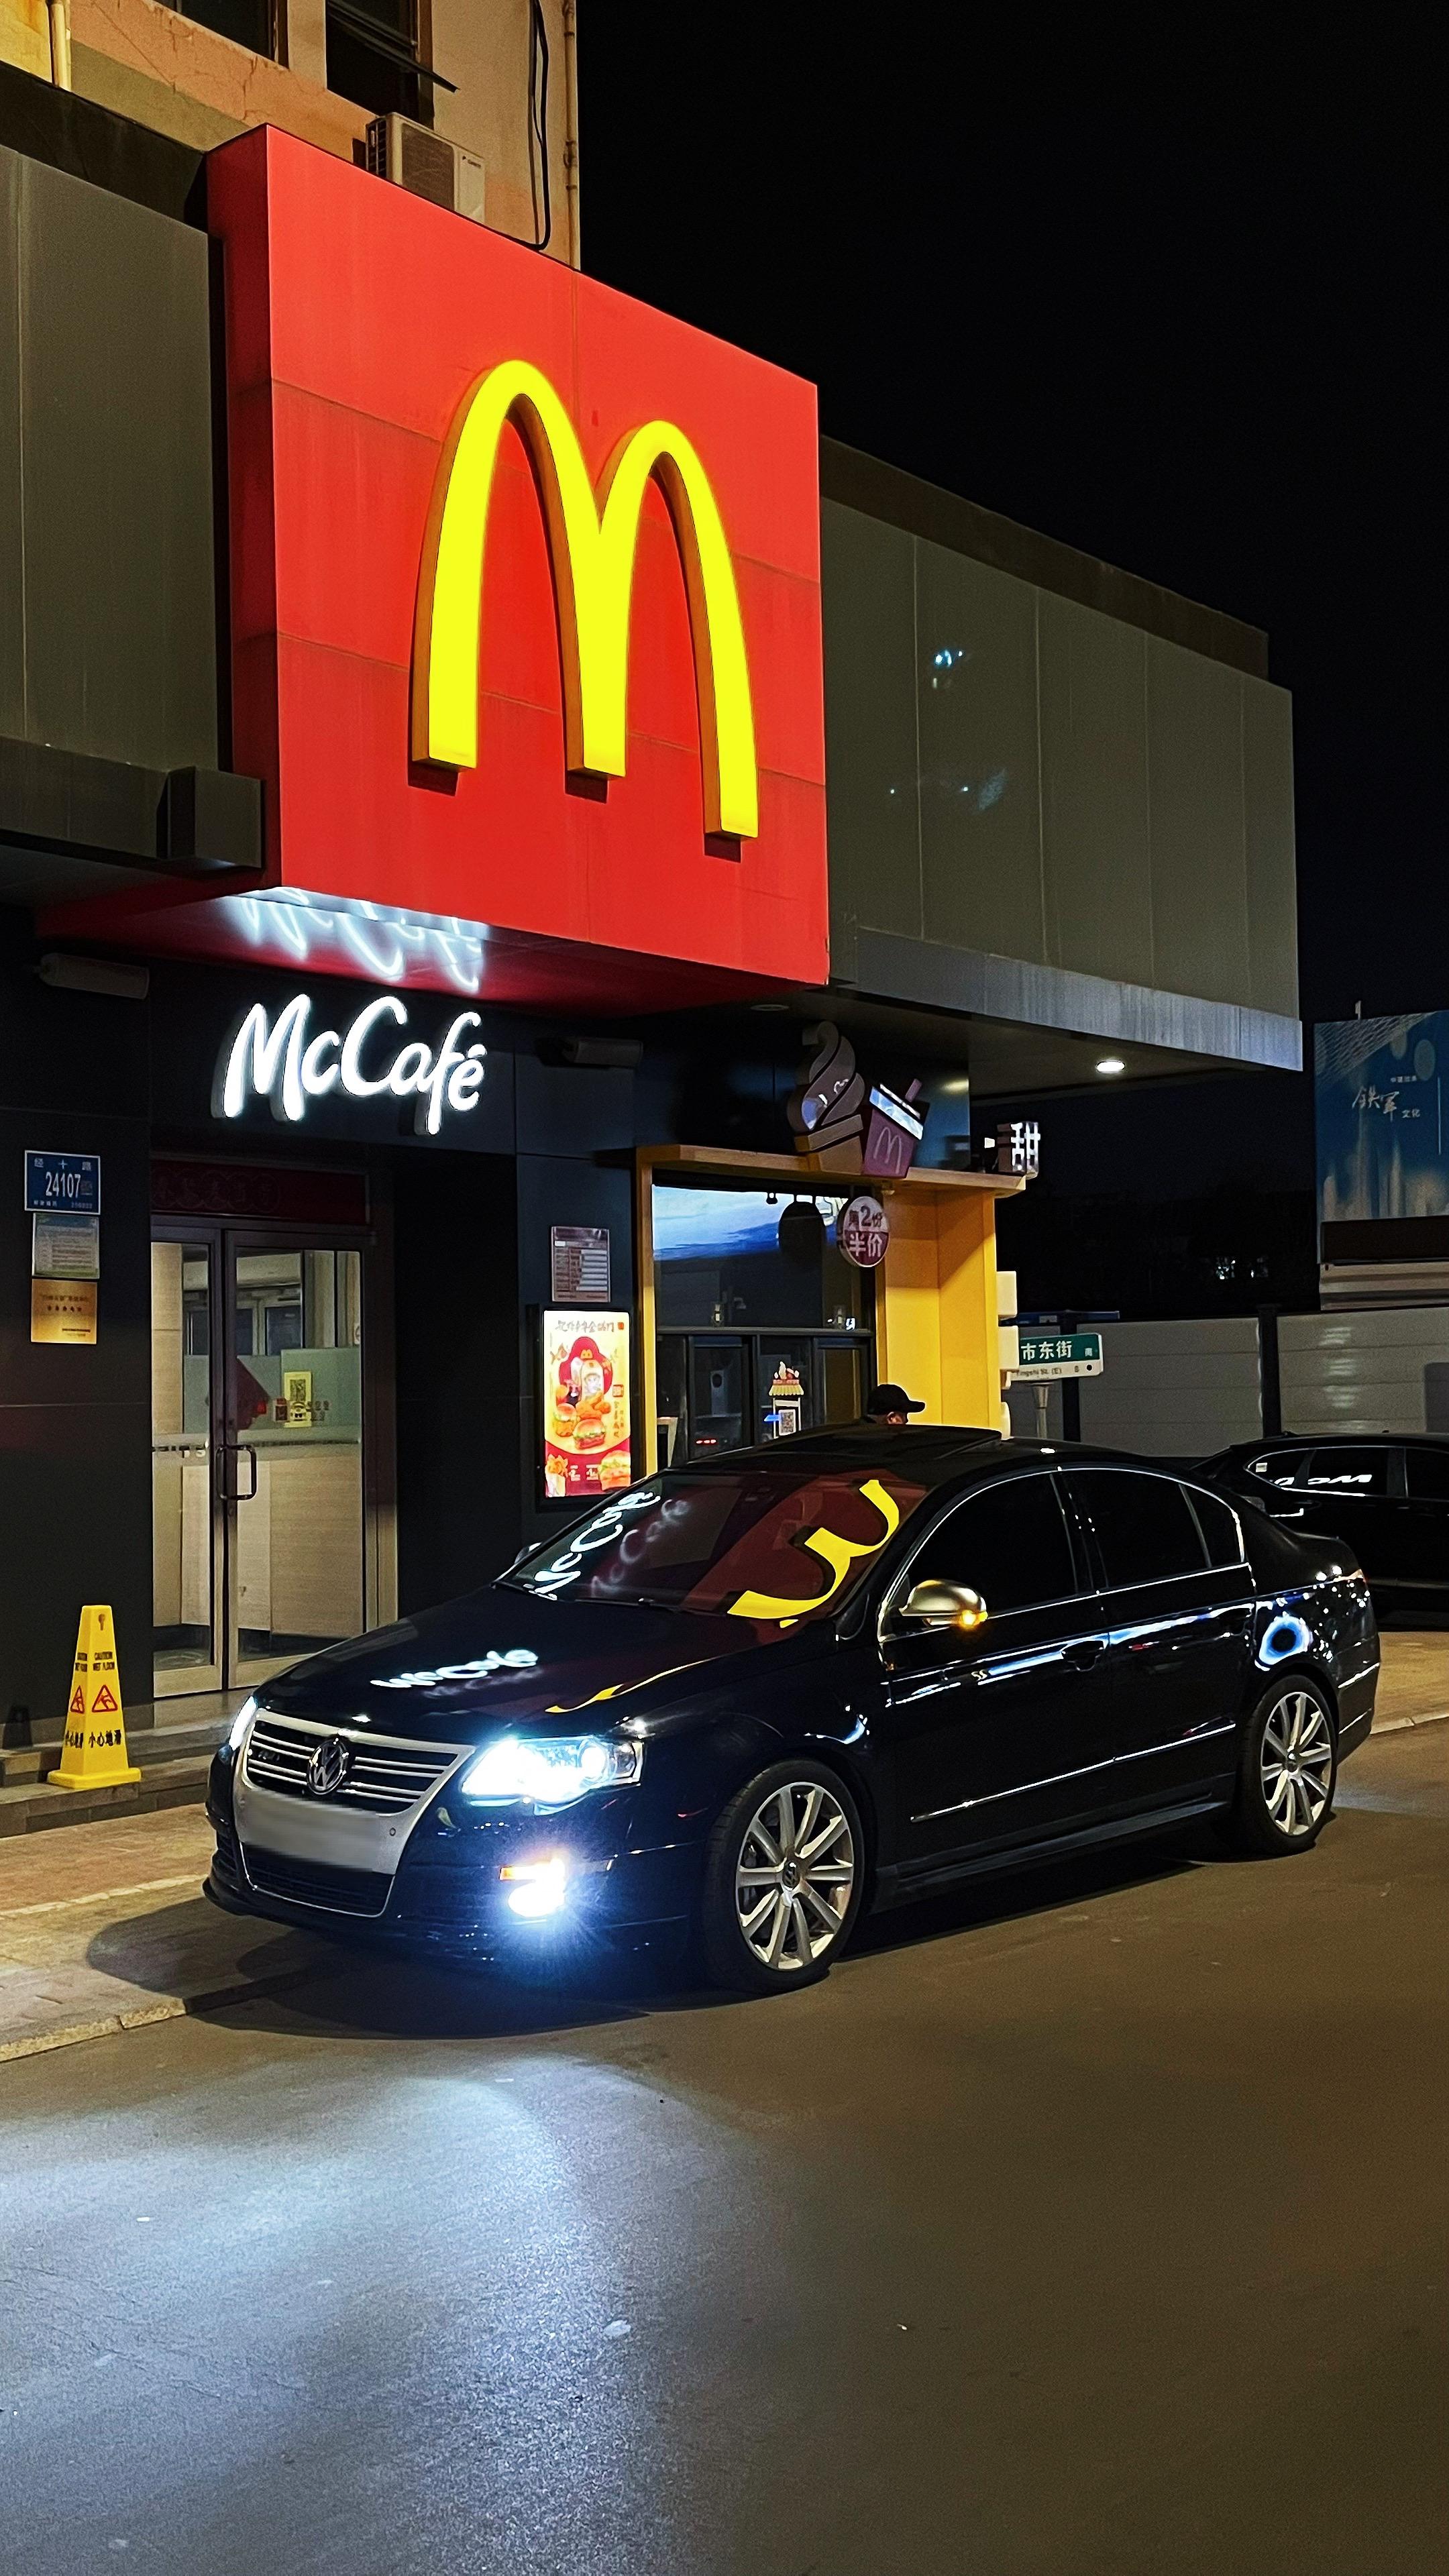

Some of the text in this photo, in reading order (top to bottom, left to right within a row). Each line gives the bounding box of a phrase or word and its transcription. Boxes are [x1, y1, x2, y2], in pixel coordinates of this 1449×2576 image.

[219, 993, 487, 1136] McCafé
[45, 1171, 81, 1199] 24107
[849, 1232, 883, 1258] 半价
[1020, 1340, 1072, 1360] 市东街
